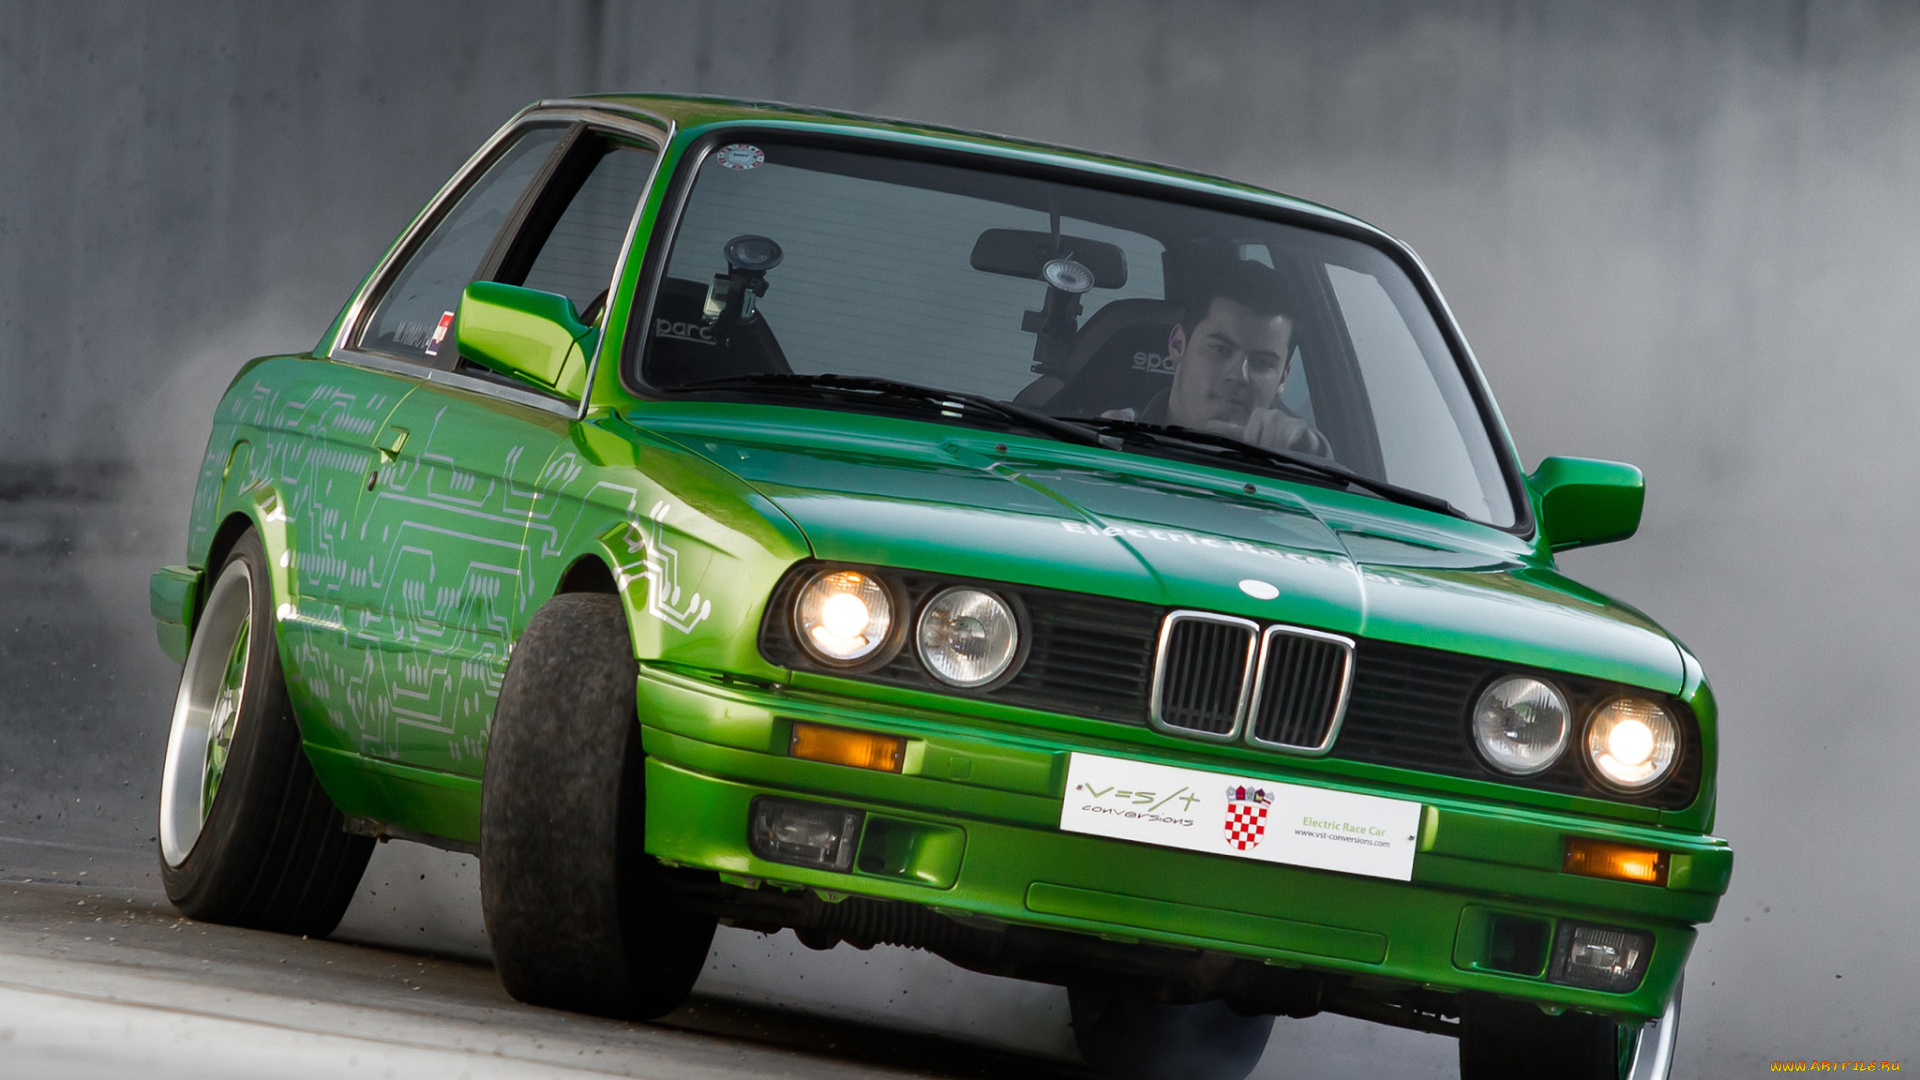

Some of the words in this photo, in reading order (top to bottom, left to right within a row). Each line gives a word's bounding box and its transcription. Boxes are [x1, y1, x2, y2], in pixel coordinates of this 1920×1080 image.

[655, 317, 716, 345] parc
[1131, 351, 1176, 375] spa
[1061, 521, 1221, 548] Electric
[1230, 540, 1328, 568] Race
[1081, 805, 1194, 827] conversions
[1302, 816, 1341, 831] Electric
[1342, 822, 1367, 835] Race
[1368, 826, 1386, 837] Car
[1294, 829, 1390, 848] www.vst-conversions.com
